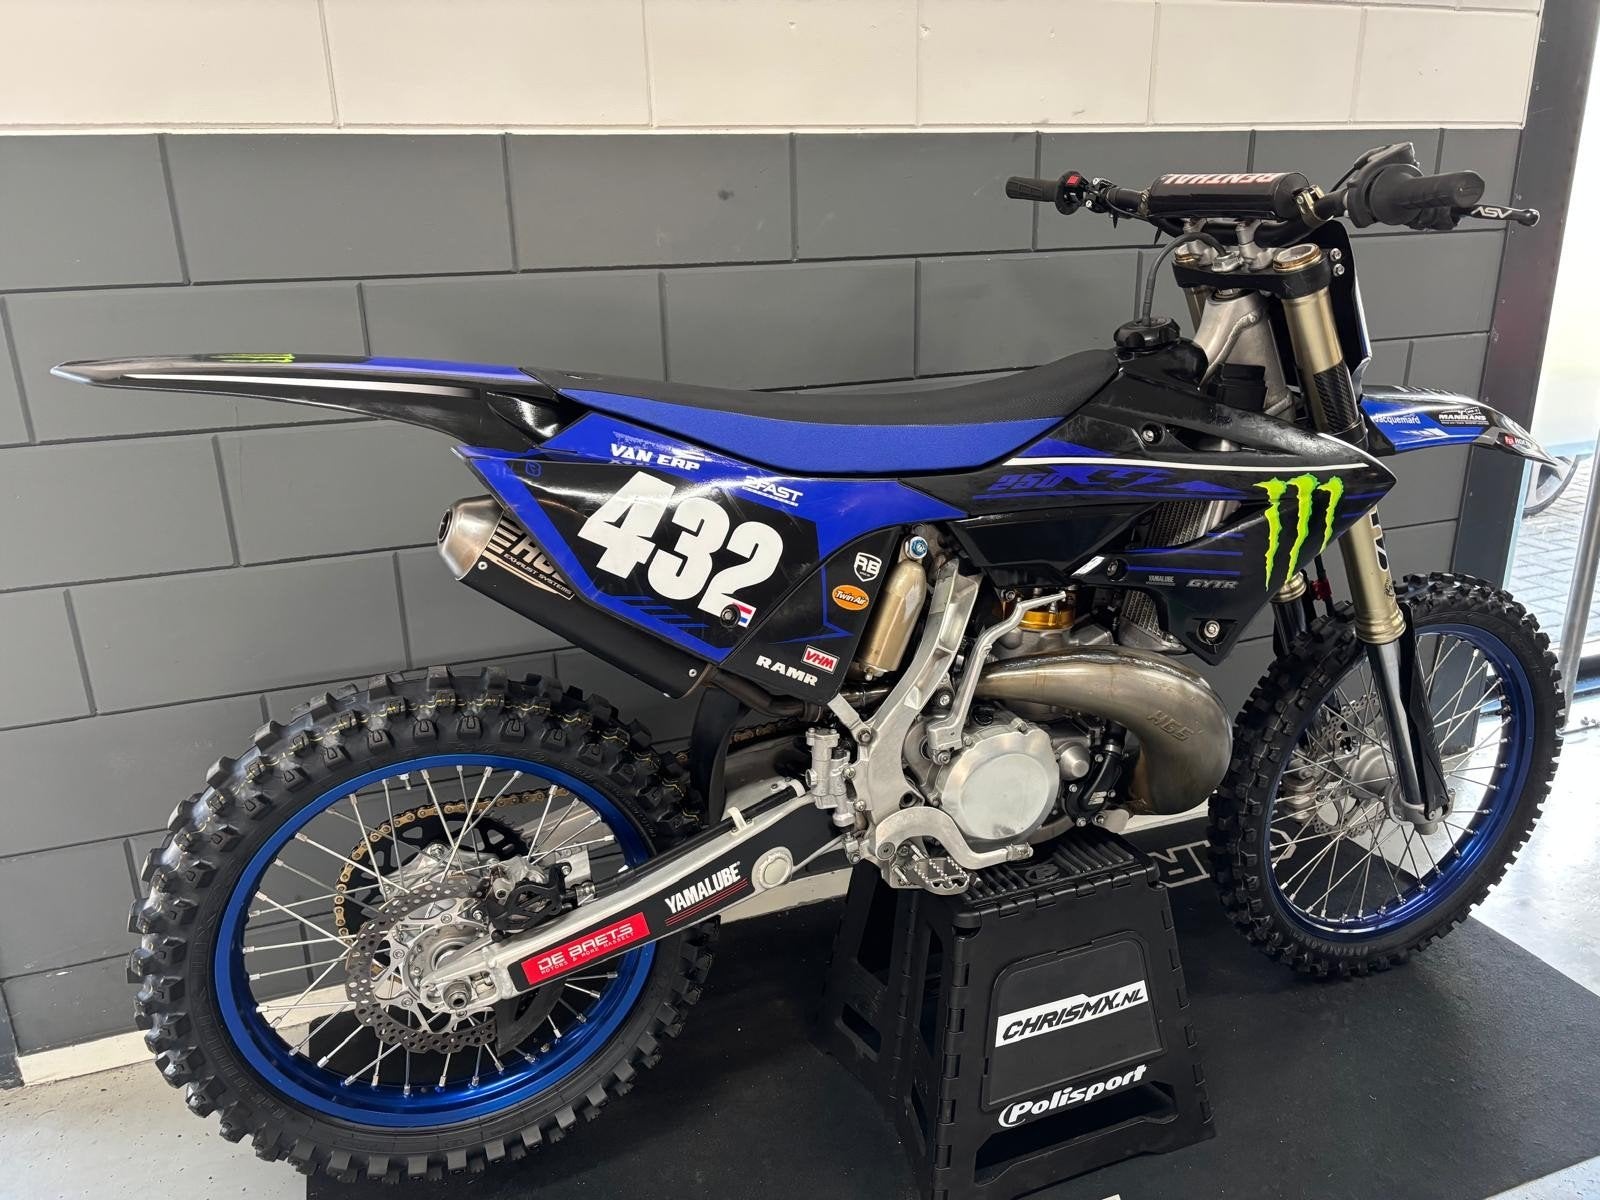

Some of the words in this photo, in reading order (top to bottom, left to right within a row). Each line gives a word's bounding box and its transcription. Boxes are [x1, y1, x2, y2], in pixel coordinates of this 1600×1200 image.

[1471, 206, 1513, 219] ASV
[611, 443, 653, 463] VAN
[657, 454, 700, 471] ERP
[577, 471, 784, 620] 432
[503, 553, 539, 576] EXHAUST
[539, 573, 573, 595] SYSTEMS
[1185, 579, 1240, 589] GYTR
[835, 590, 854, 602] Twin
[852, 595, 867, 606] Air
[756, 655, 819, 687] RAMR
[805, 650, 835, 670] VHM
[664, 864, 741, 914] YAMALUBE
[537, 951, 565, 972] DE
[541, 961, 569, 975] MOTORS
[581, 947, 600, 958] MORE
[603, 932, 635, 948] HASSELT
[1002, 987, 1144, 1042] CHRISMX.NL
[998, 1064, 1148, 1128] Polisport
